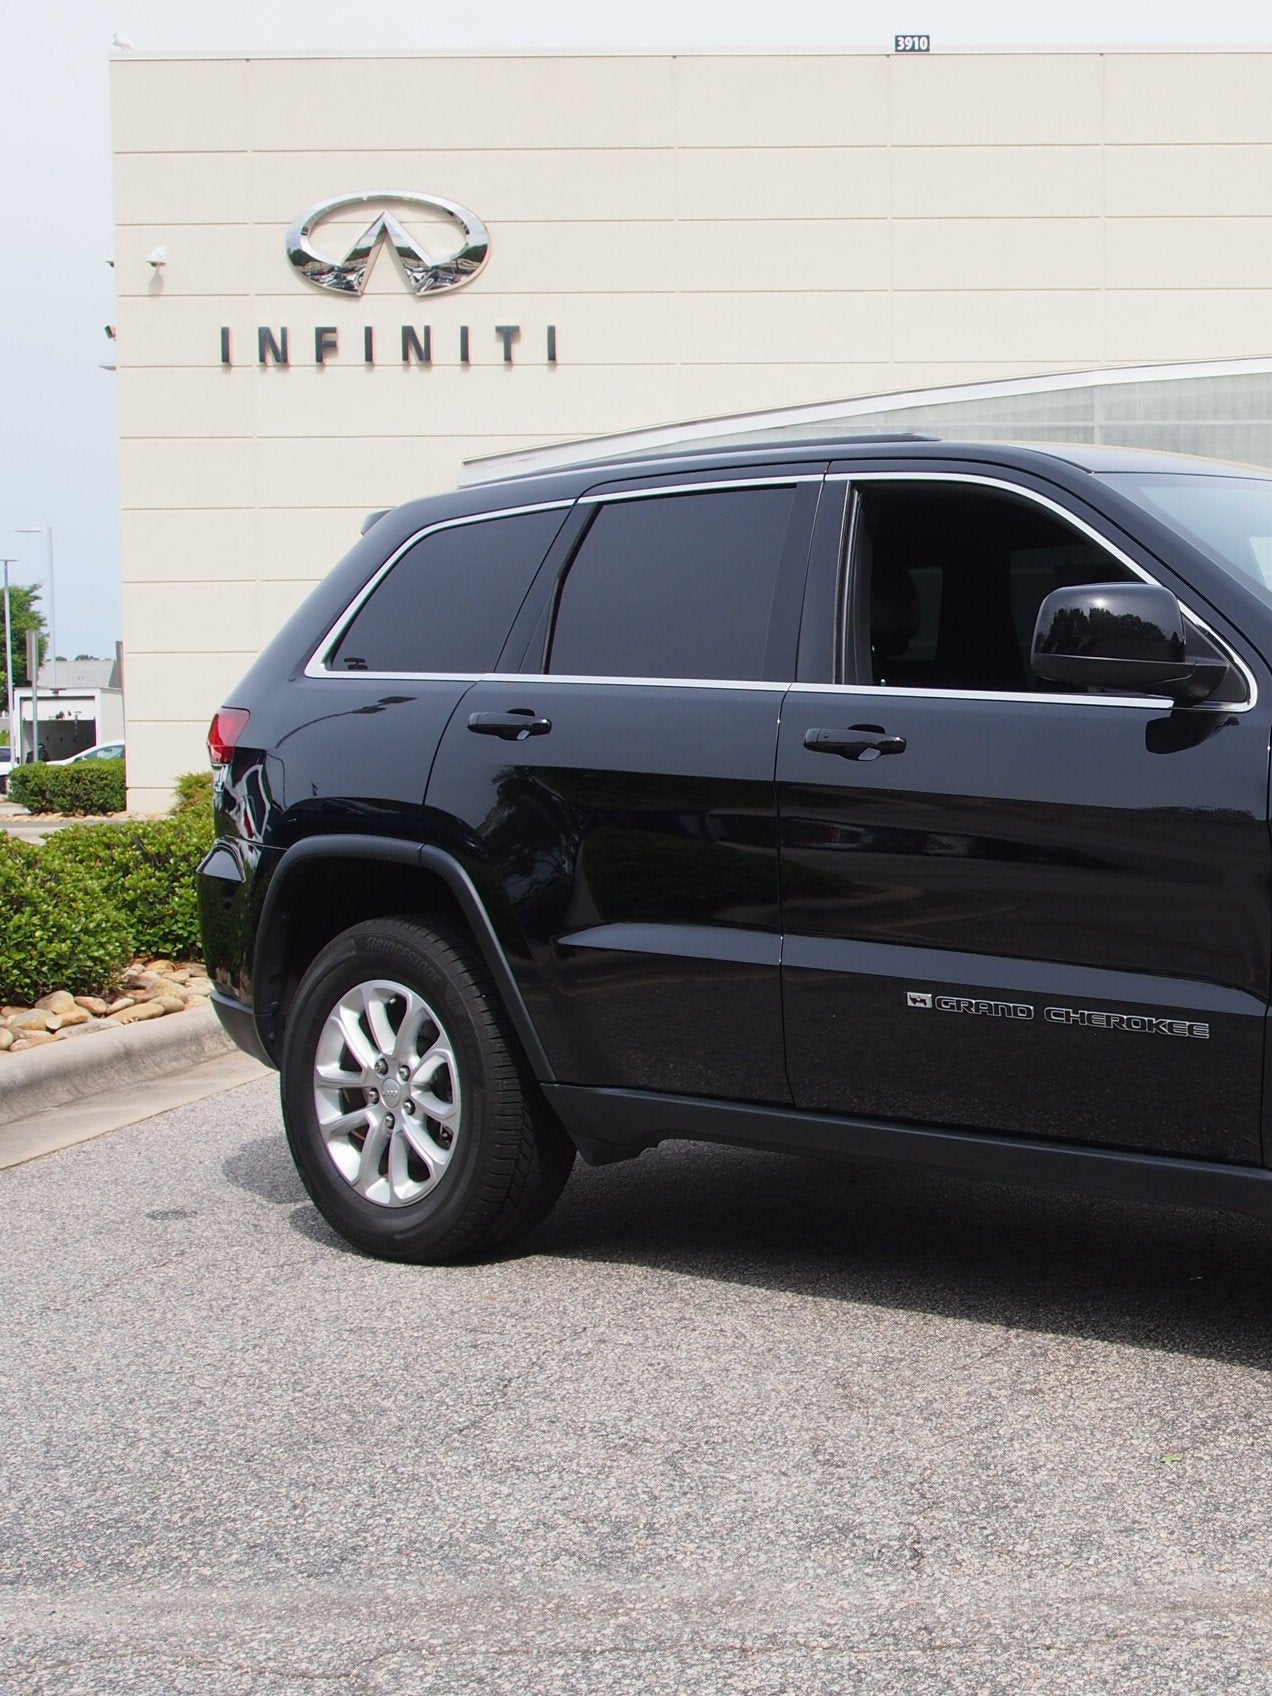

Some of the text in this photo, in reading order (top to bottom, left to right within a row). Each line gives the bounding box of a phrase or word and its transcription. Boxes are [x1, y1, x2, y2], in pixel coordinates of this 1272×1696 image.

[897, 36, 928, 50] 3910
[221, 325, 556, 363] INFINITI
[935, 996, 1210, 1039] GRAND CHEROKEE
